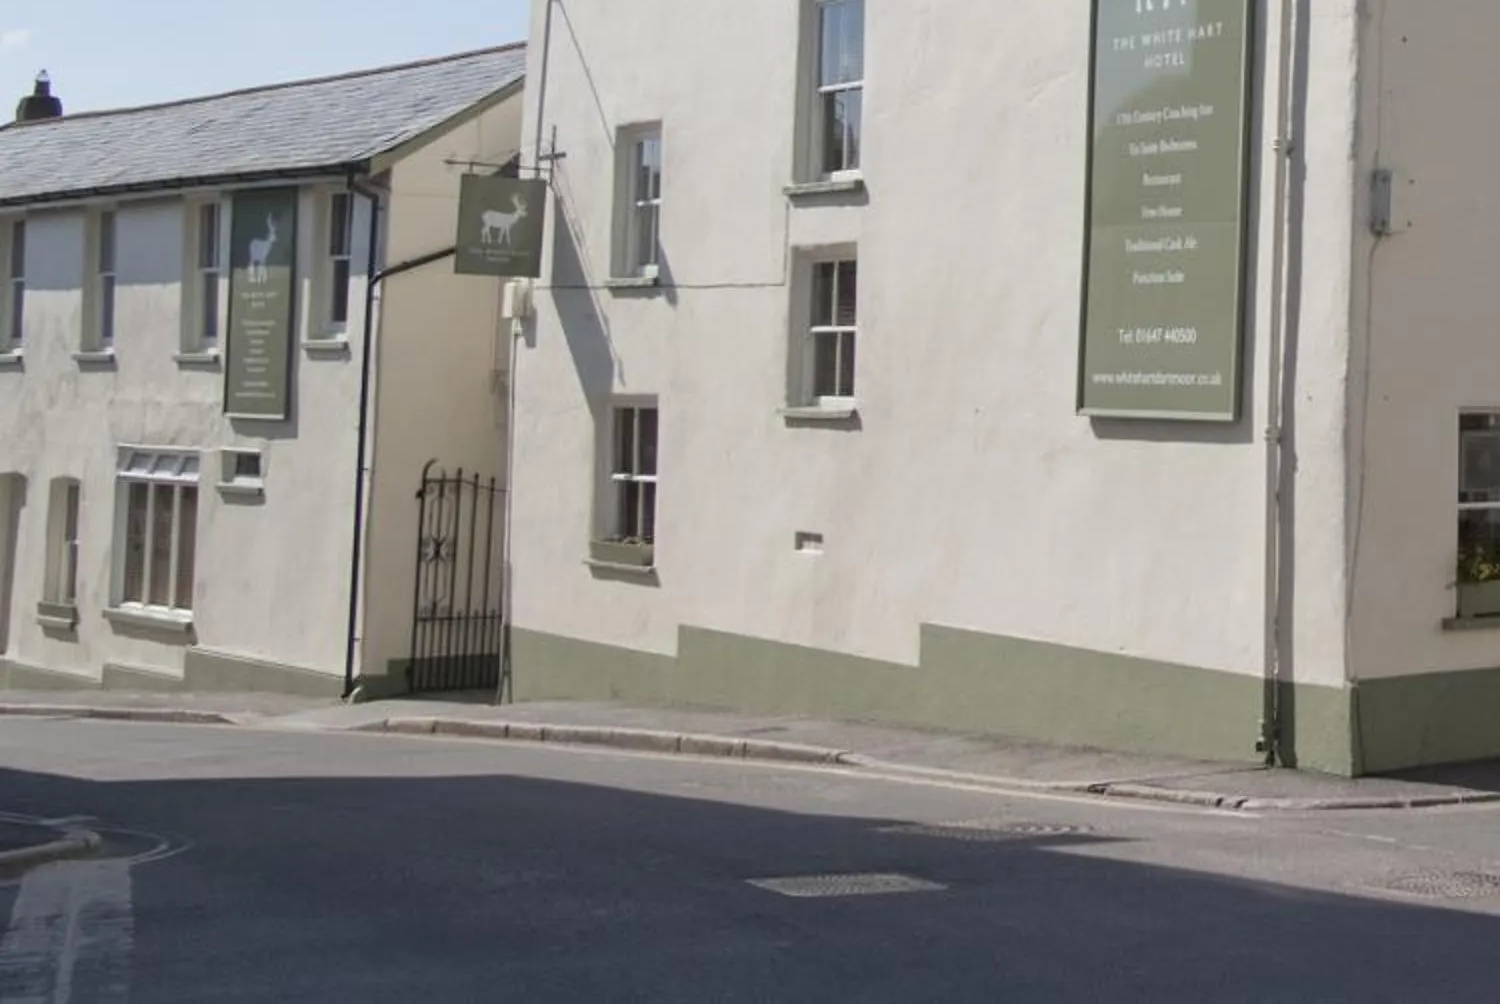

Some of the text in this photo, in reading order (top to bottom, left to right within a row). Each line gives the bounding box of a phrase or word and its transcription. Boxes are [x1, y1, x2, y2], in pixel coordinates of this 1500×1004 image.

[1112, 22, 1223, 52] THE WHITE HART
[1143, 51, 1185, 68] HOTEL
[1135, 326, 1162, 344] 01647
[1164, 326, 1197, 344] 440500
